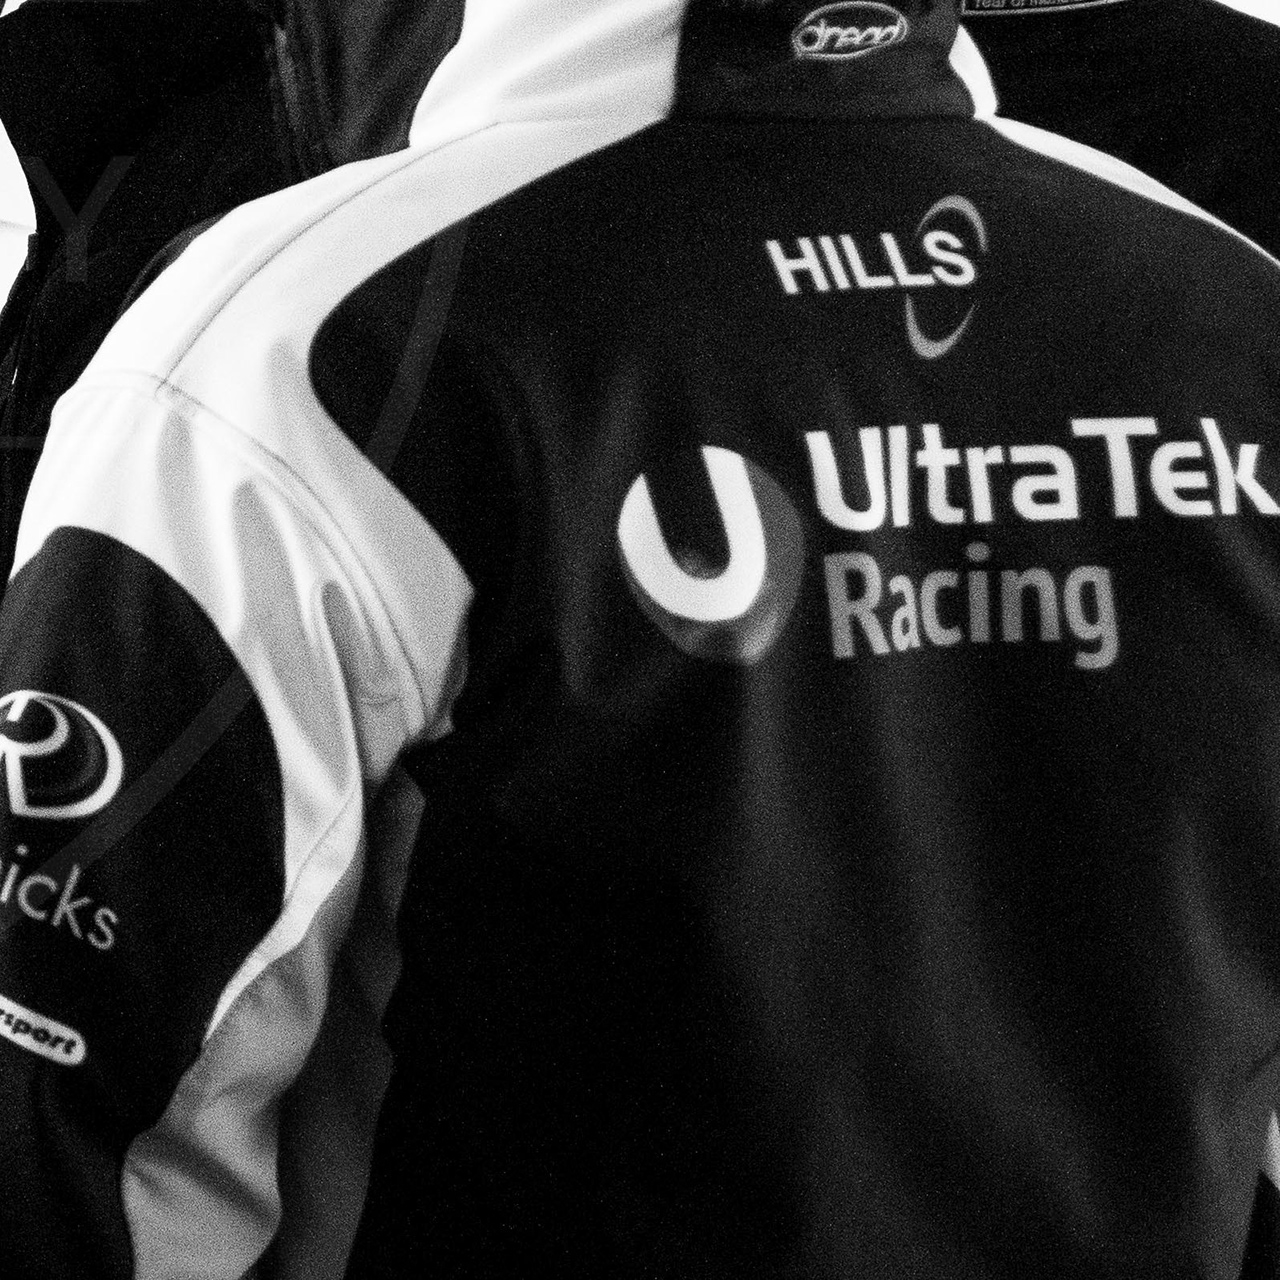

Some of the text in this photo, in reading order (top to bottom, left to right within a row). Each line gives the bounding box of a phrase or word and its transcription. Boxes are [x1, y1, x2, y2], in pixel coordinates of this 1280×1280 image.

[766, 230, 977, 295] HILLS
[804, 417, 1280, 532] UltraTek
[823, 541, 1120, 670] Racing
